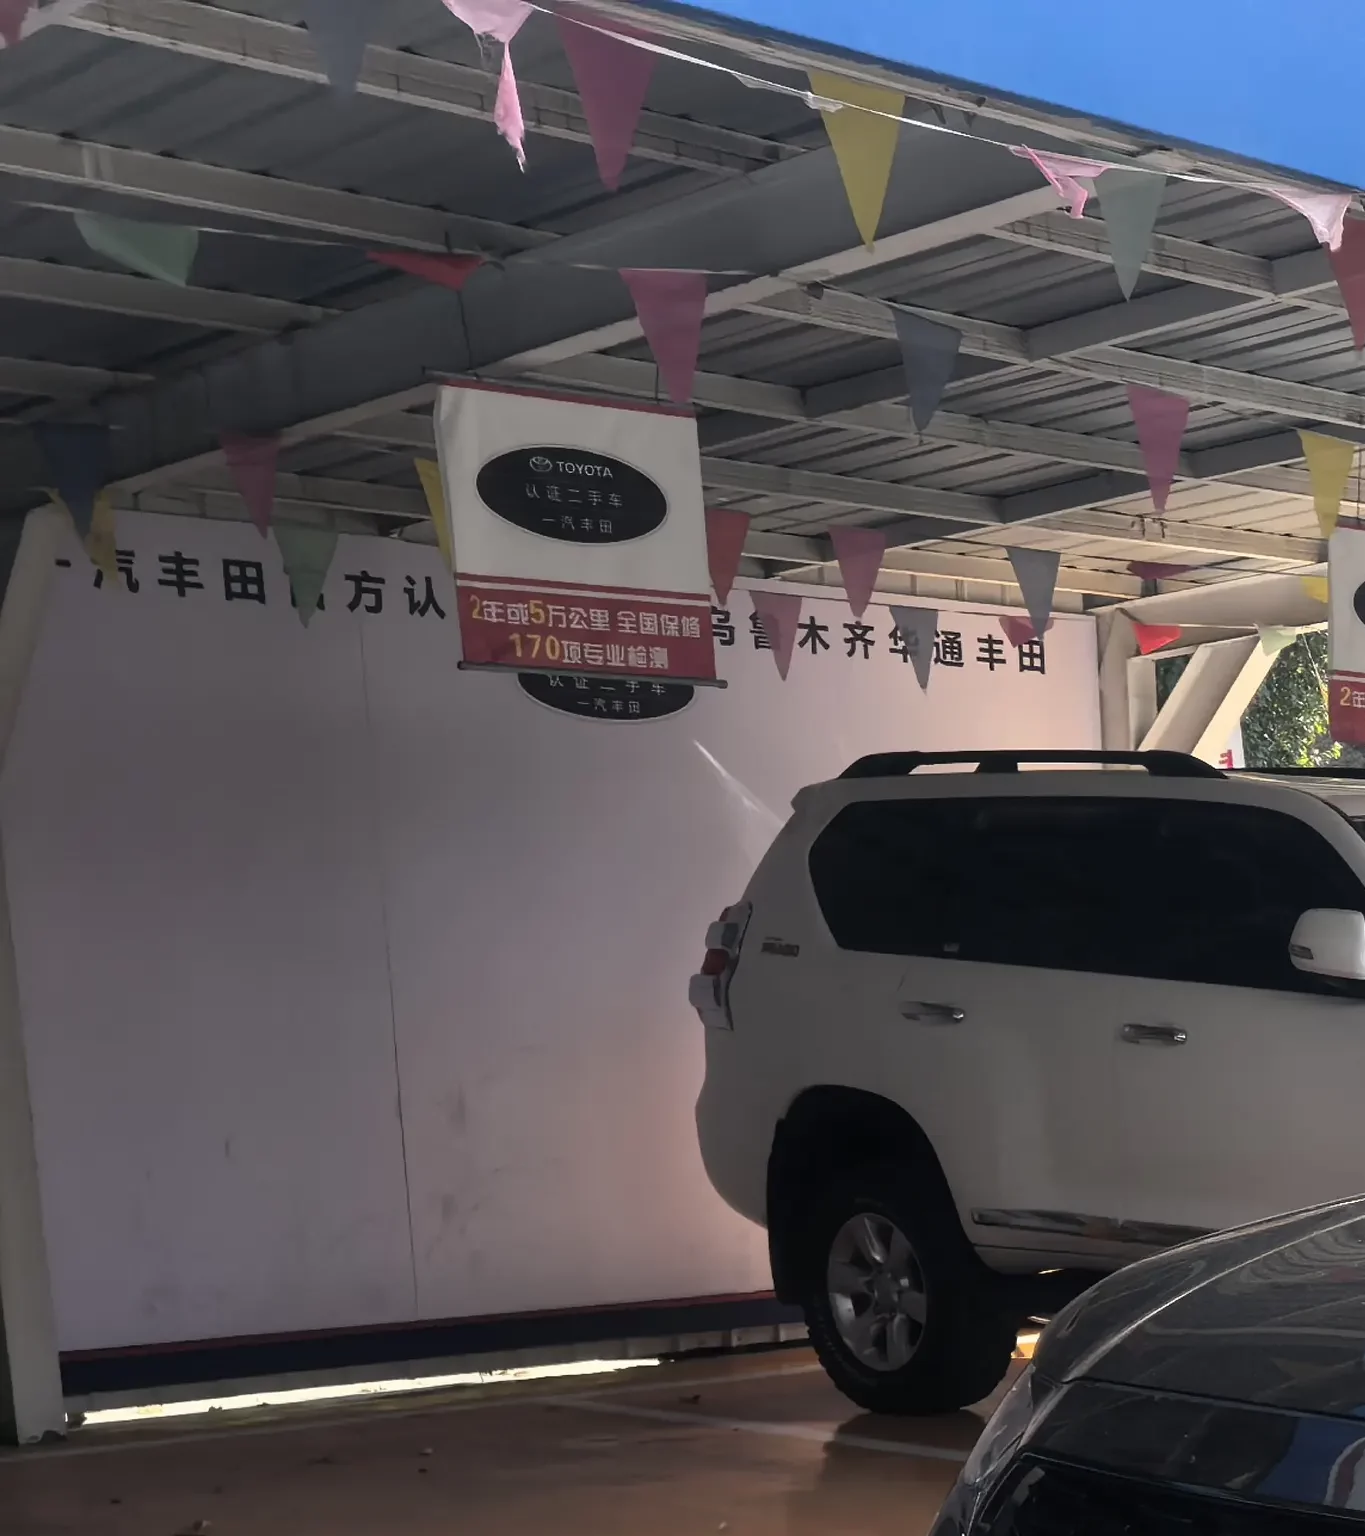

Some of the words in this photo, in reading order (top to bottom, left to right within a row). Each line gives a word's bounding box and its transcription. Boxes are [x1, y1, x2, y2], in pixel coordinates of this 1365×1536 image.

[556, 461, 613, 479] TOYOTA
[525, 484, 623, 508] 认证二手车
[542, 515, 613, 534] 一汽丰田
[469, 594, 610, 631] 2年或5万公里
[617, 610, 701, 639] 全国保修
[509, 632, 669, 669] 170项专业检测
[577, 698, 640, 714] 一汽丰田
